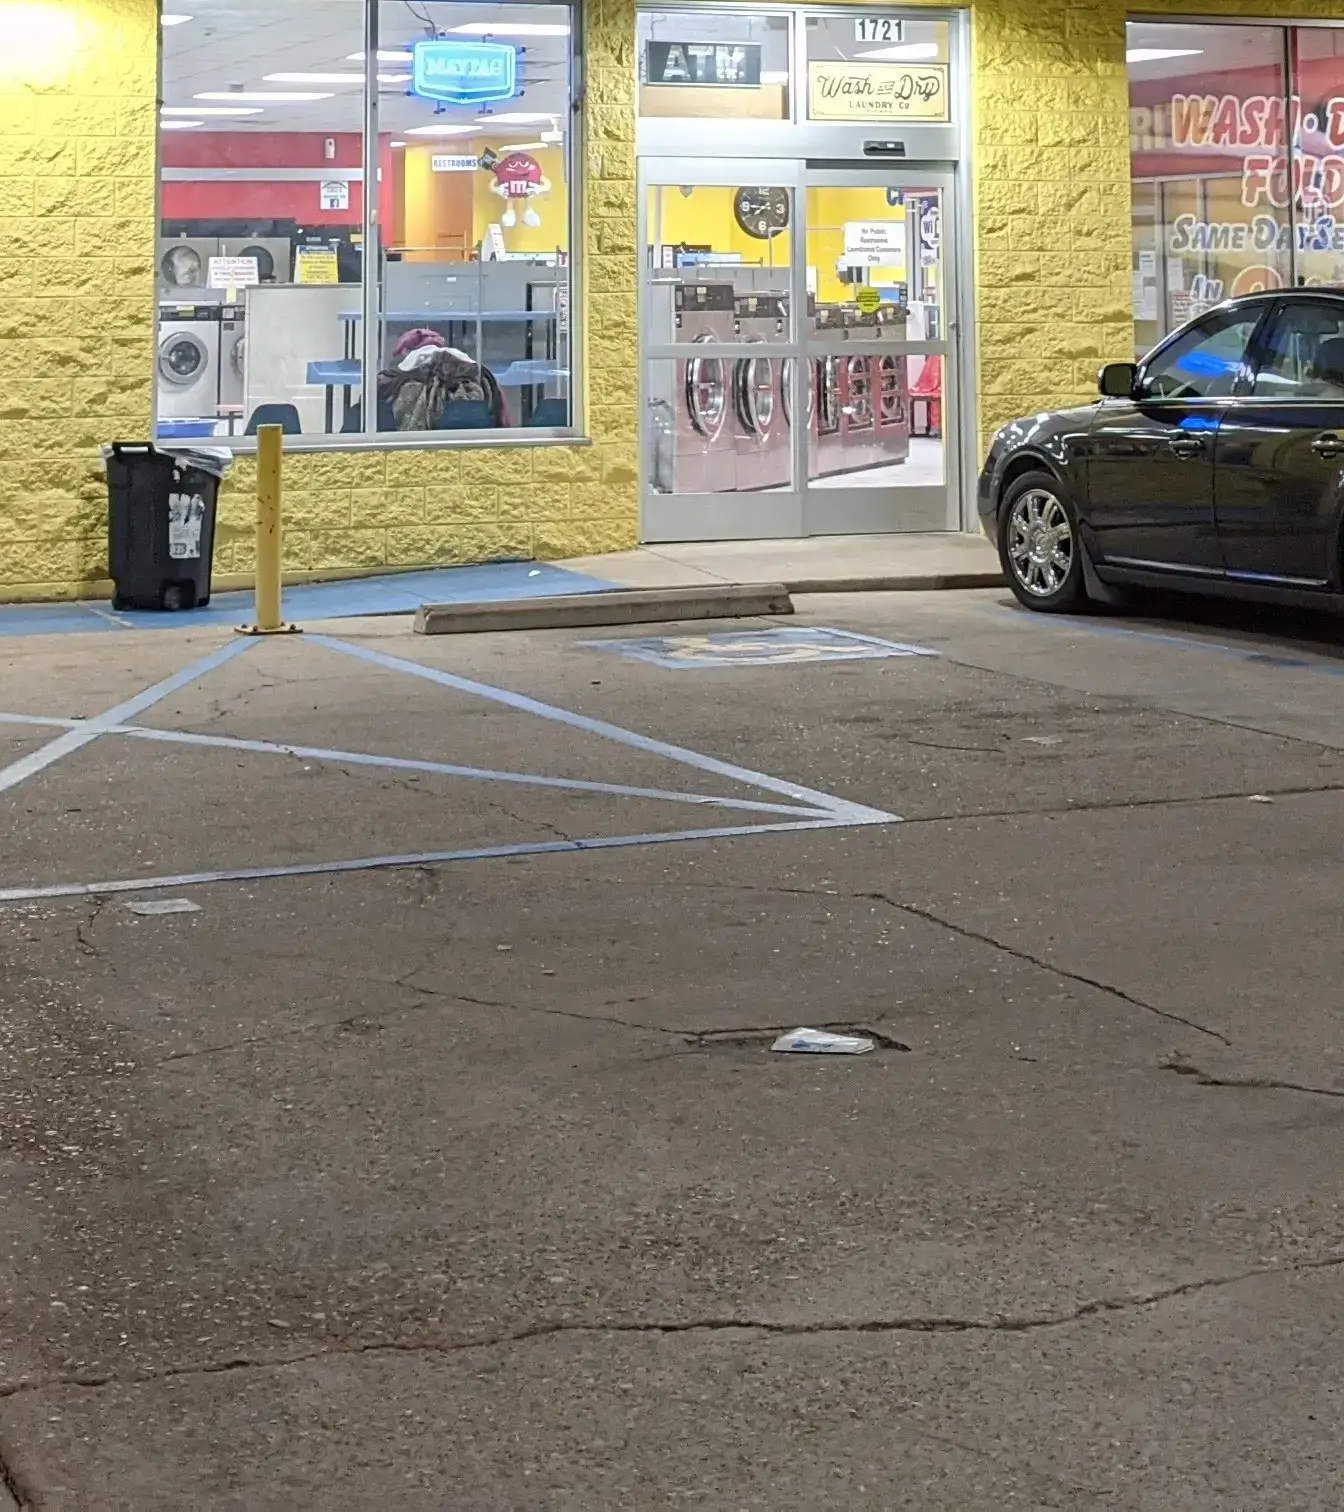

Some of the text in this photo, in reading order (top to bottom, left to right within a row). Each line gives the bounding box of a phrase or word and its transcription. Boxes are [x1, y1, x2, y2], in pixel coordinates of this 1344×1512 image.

[859, 19, 902, 40] 1721
[424, 57, 504, 77] MAYTAG
[662, 45, 745, 81] ATM
[817, 74, 874, 98] Wash
[894, 74, 940, 102] Dry
[849, 101, 893, 109] LAUNDRY
[1171, 94, 1301, 150] WASH
[433, 159, 476, 167] RESTROOMS
[1172, 213, 1245, 252] SAME
